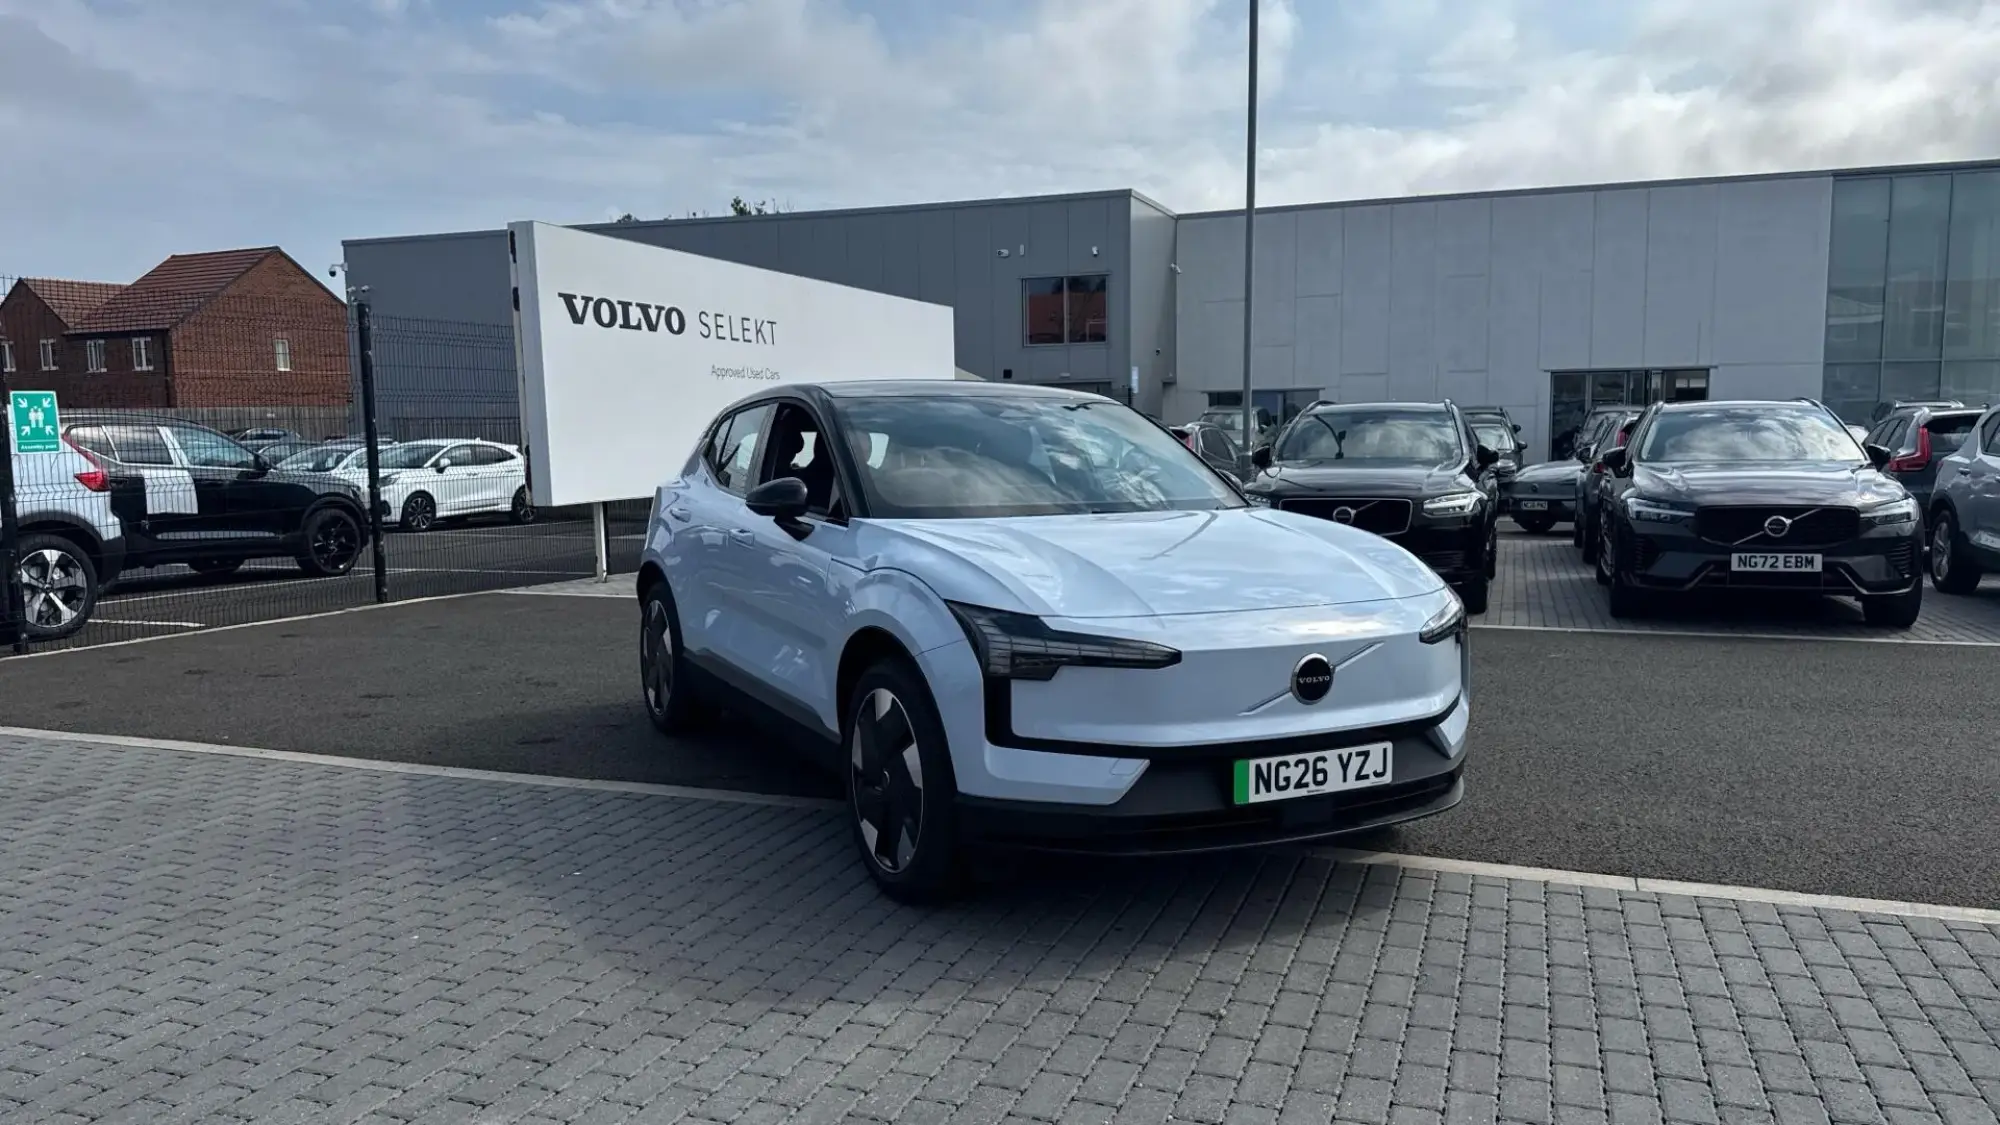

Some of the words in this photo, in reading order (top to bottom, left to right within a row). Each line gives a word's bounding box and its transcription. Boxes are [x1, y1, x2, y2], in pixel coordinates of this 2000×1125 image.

[557, 292, 686, 335] VOLVO
[698, 310, 777, 346] SELEKT
[711, 363, 745, 381] Approved
[746, 366, 764, 380] Used
[765, 367, 781, 380] Cars
[1737, 555, 1779, 569] NG72
[1782, 555, 1815, 569] EBM
[1299, 675, 1330, 684] VOLVO
[1254, 755, 1328, 795] NG26
[1337, 747, 1388, 783] YZJ
